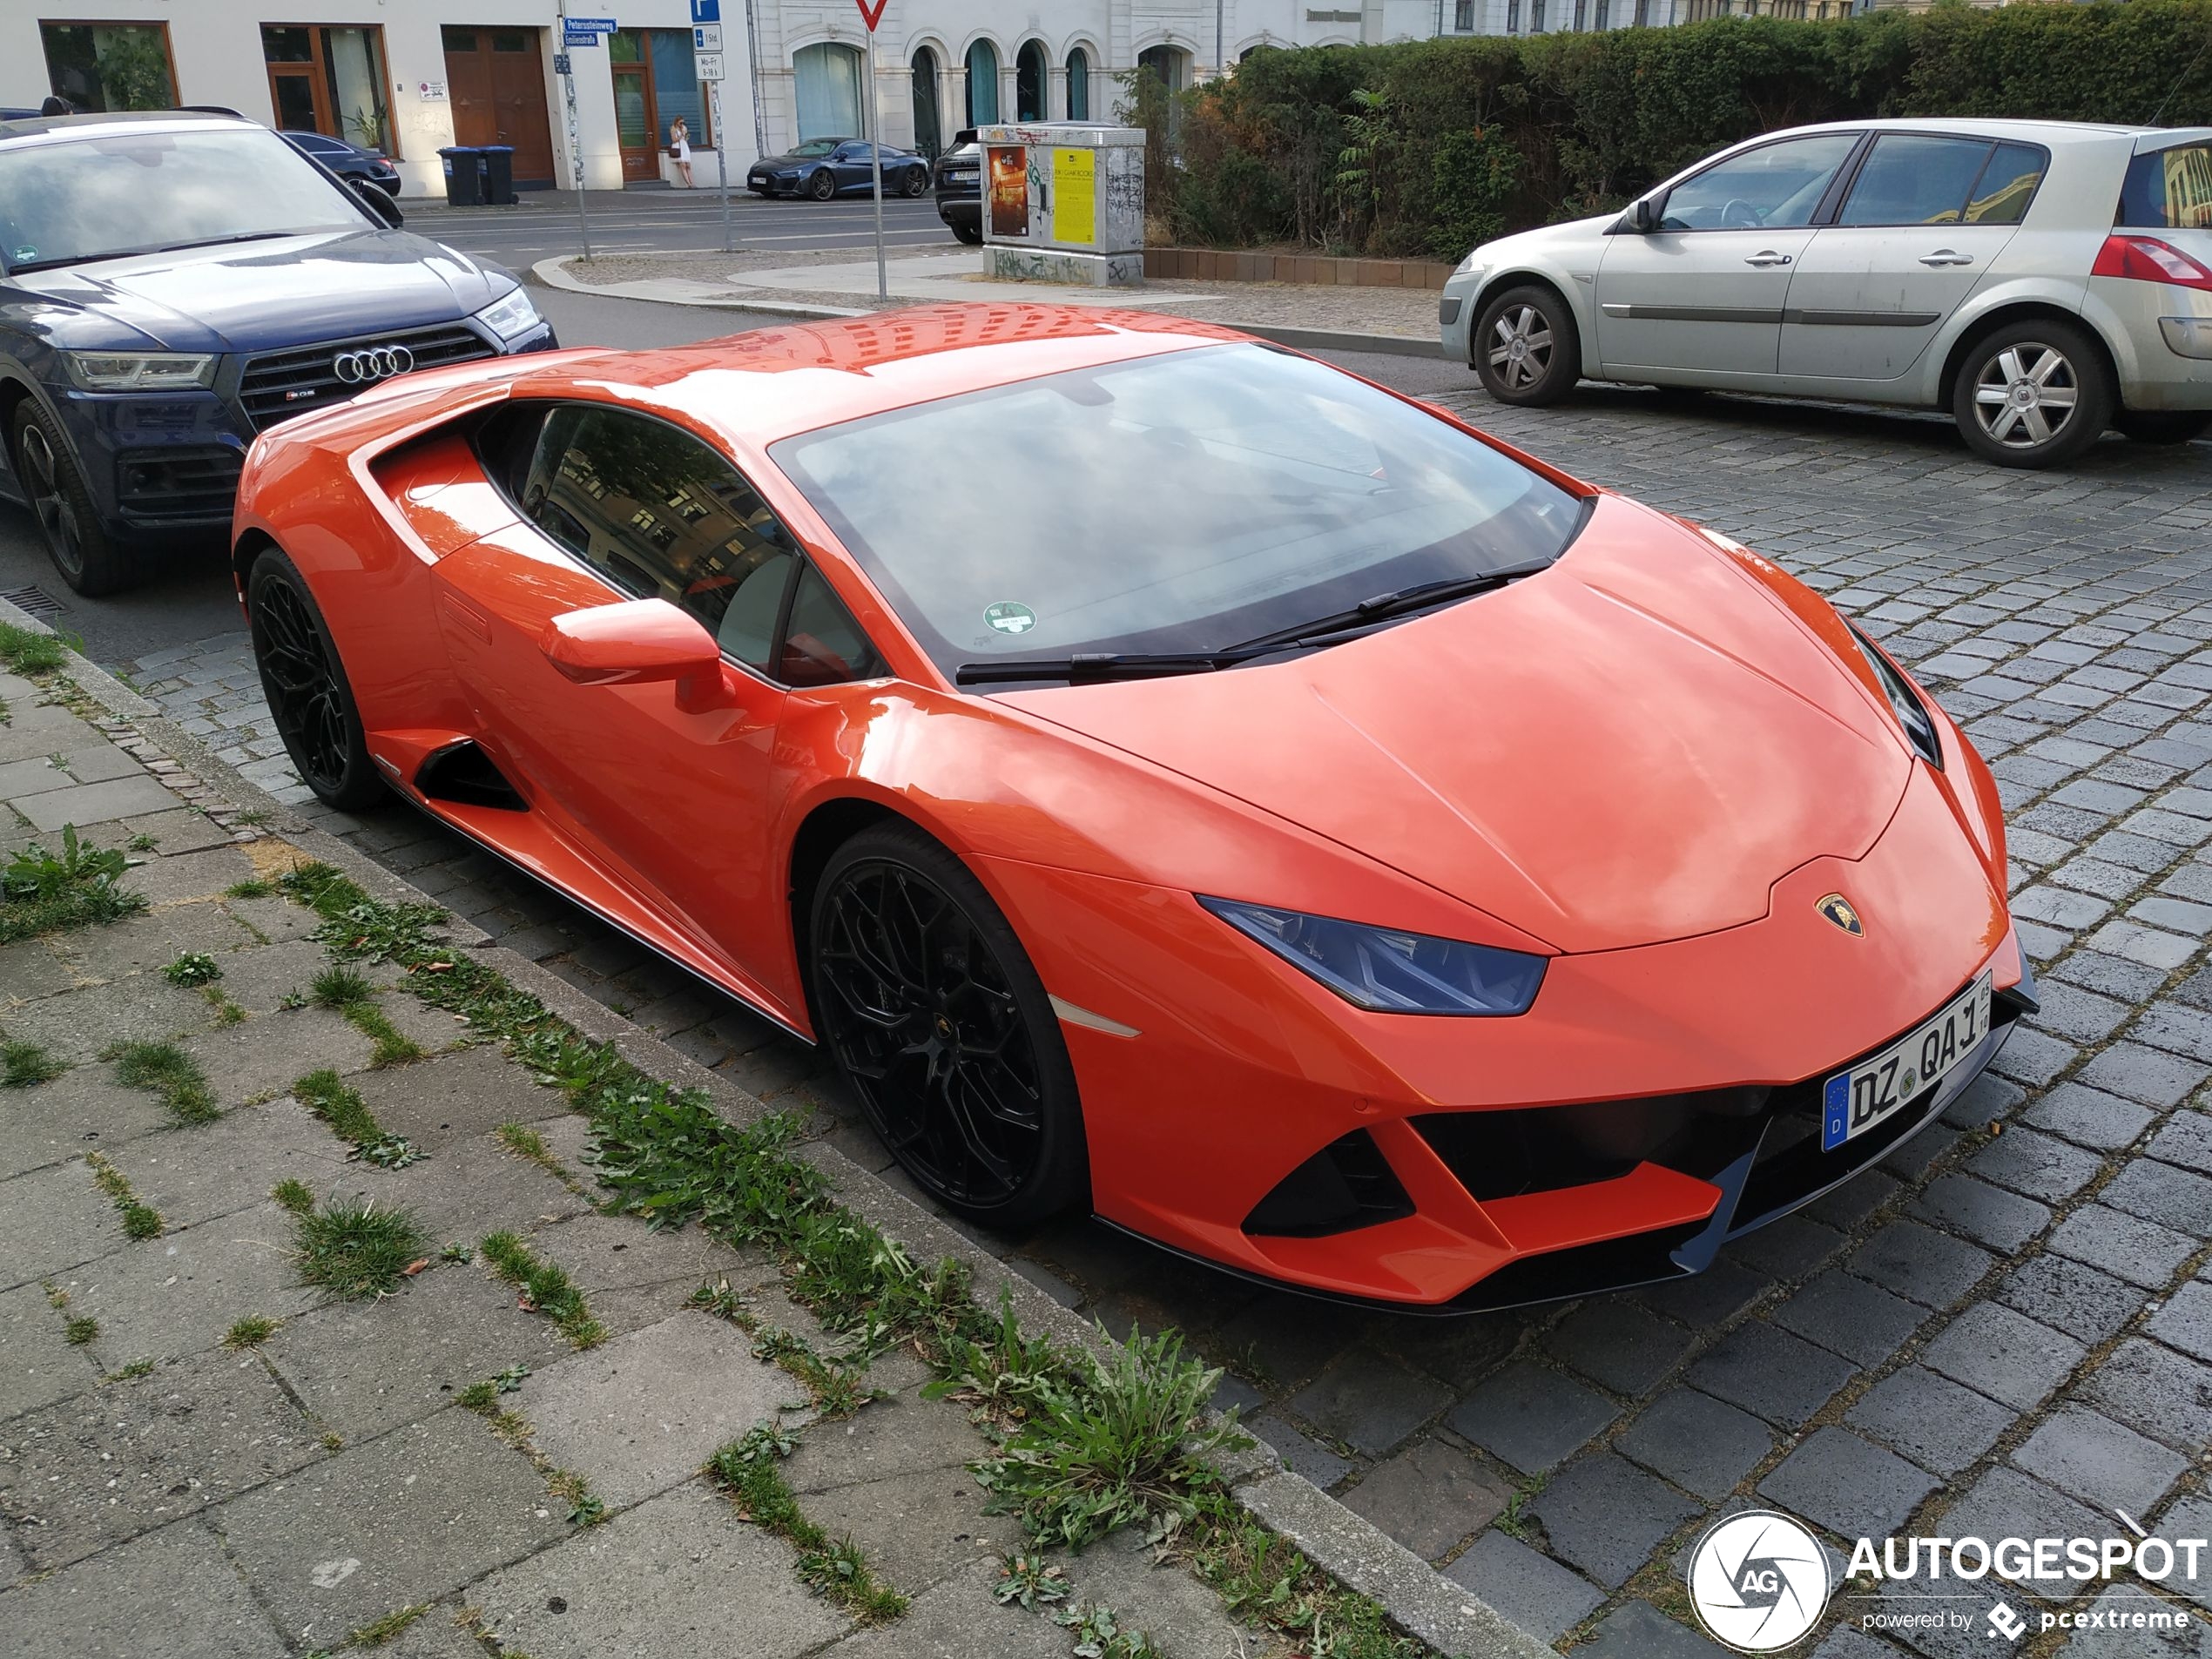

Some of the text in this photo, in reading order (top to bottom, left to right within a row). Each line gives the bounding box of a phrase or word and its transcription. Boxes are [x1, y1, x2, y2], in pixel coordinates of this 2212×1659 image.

[568, 19, 613, 33] Peterssteinweg
[709, 33, 718, 43] Std.
[701, 57, 717, 66] Mo-Fr
[1980, 981, 1990, 1001] 05
[1979, 1014, 1988, 1033] 10
[1832, 1119, 1841, 1134] D
[1851, 1055, 1900, 1129] DZ
